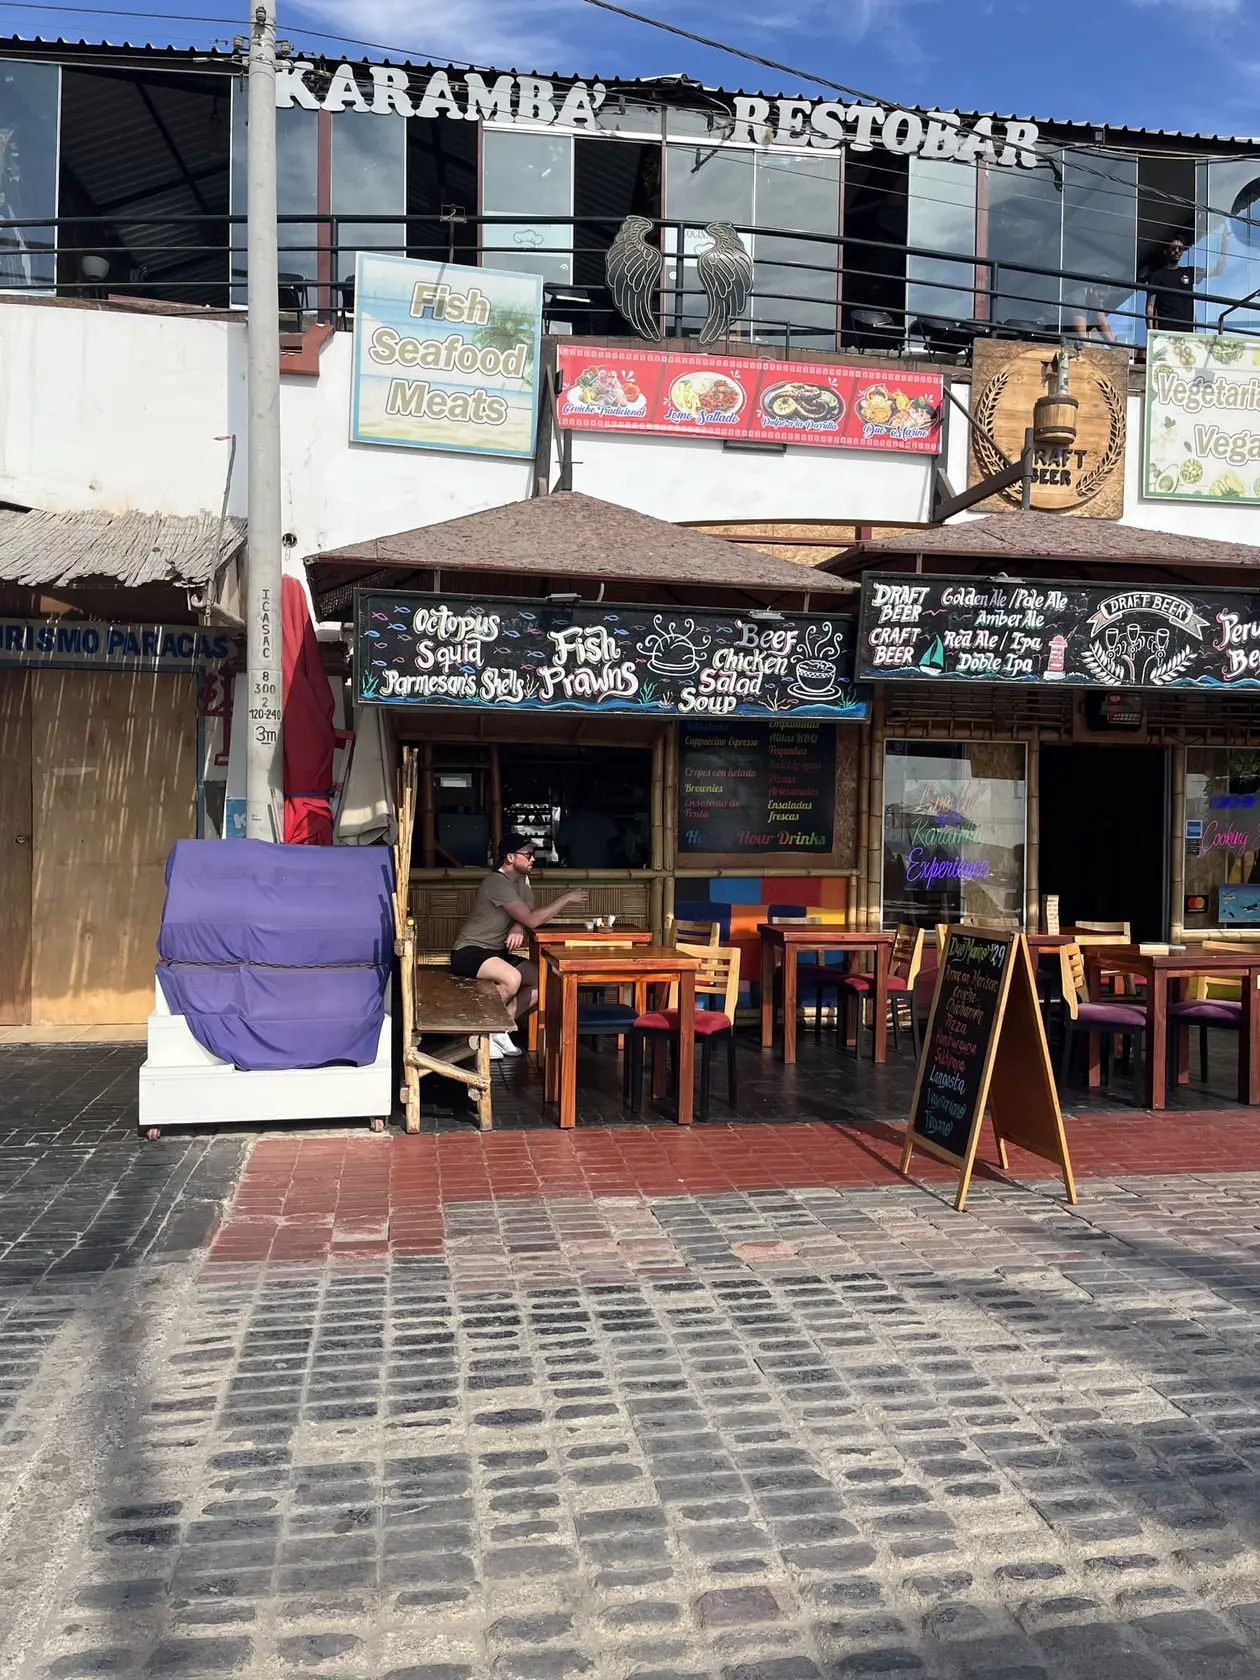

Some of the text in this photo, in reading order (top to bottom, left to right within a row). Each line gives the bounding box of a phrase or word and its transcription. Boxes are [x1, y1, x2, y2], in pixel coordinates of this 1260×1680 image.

[731, 97, 1039, 168] RESTOBAR
[409, 280, 491, 326] Fish
[368, 327, 527, 379] Seafood
[385, 378, 508, 425] Meats
[1157, 372, 1260, 414] Vegetari
[562, 402, 647, 418] Ceviche Tradicional
[663, 408, 740, 425] Lomo Saltado
[863, 423, 929, 441] Duo Marino
[1032, 449, 1087, 470] RAFT
[1030, 469, 1072, 486] BEER
[872, 582, 930, 606] DRAFT
[941, 586, 989, 606] Golden
[990, 588, 1007, 607] Ale
[1045, 590, 1069, 610] Ale
[878, 605, 923, 624] BEER
[974, 609, 1046, 629] Amber Ale
[1110, 594, 1187, 620] DRAFT BEER
[413, 605, 500, 643] Octopus
[0, 624, 229, 659] RISMO PARACAS
[547, 625, 621, 666] Fish
[733, 619, 800, 655] Beef
[868, 627, 921, 646] CRAFT
[944, 630, 973, 649] Red
[974, 630, 998, 650] Ale
[1009, 631, 1043, 655] Ipa
[414, 639, 485, 674] Squid
[711, 648, 789, 675] Chicken
[872, 646, 915, 666] BEER
[956, 651, 1034, 677] Doble Ipa
[262, 671, 269, 681] 8
[379, 667, 525, 703] Parmesan's Shells
[537, 661, 639, 703] Prawns
[698, 667, 763, 696] Salad
[254, 684, 276, 694] 300
[677, 687, 737, 714] Soup
[249, 709, 281, 720] 120-240
[685, 736, 726, 747] Cappuccino
[796, 733, 818, 744] BBQ
[768, 746, 807, 757] Tequeños
[685, 767, 756, 779] Crepes con helado
[685, 783, 723, 794] Brownies
[685, 808, 709, 818] Fruta
[767, 800, 812, 810] Ensaladas
[767, 811, 799, 823] frescas
[737, 830, 773, 845] Hour
[777, 830, 826, 845] Drinks
[906, 847, 989, 889] Experience
[929, 1064, 967, 1095] Langosta
